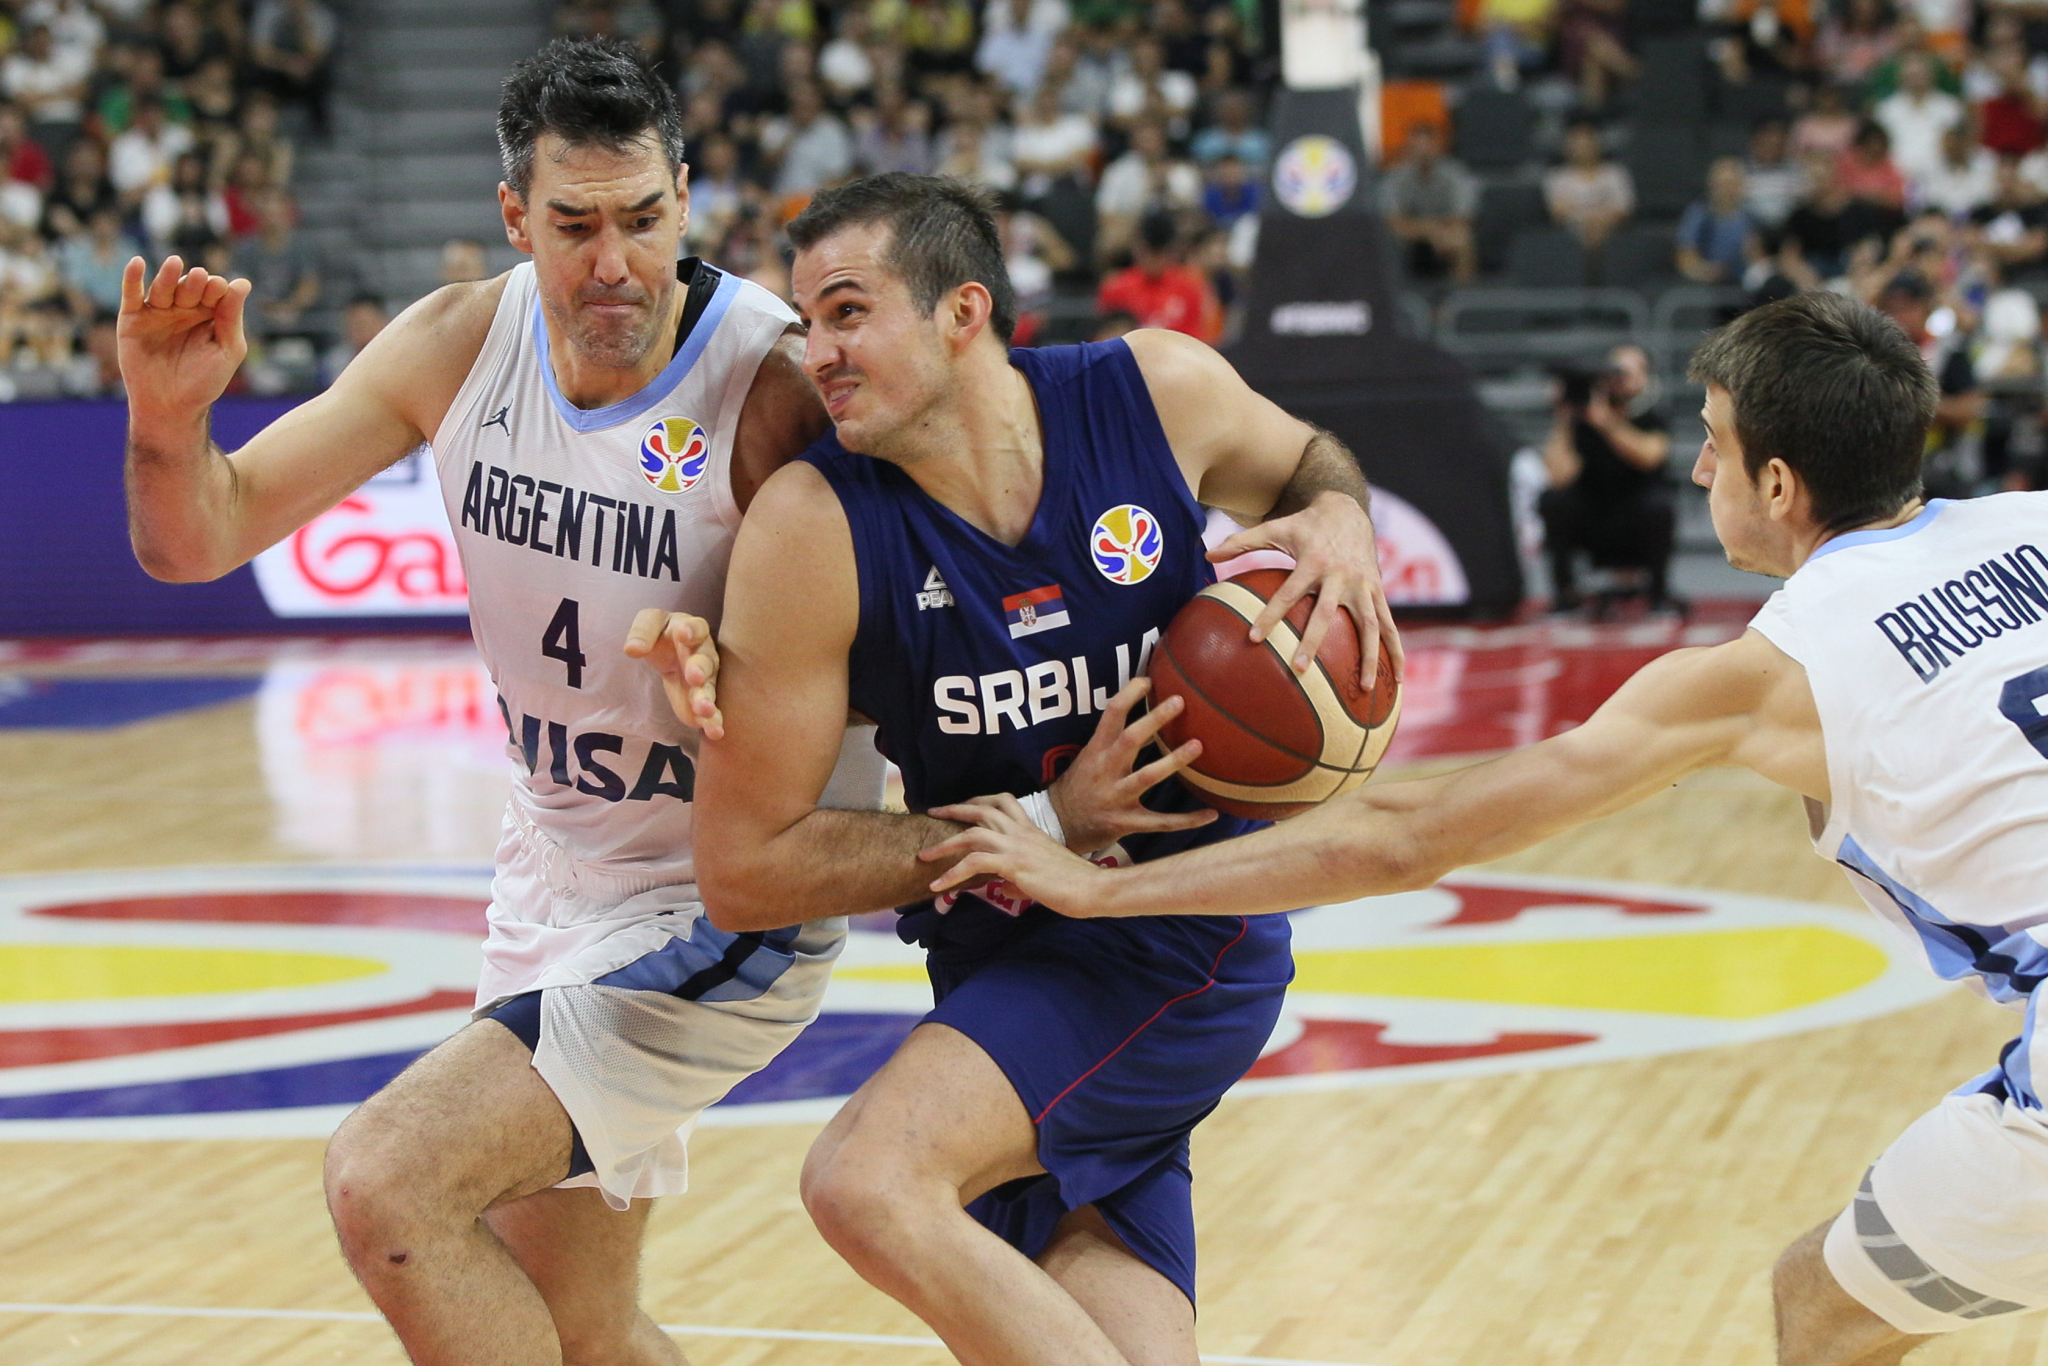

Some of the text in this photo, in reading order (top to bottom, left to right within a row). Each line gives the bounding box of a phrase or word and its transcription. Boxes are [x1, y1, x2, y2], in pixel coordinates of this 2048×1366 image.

[461, 460, 681, 582] ARGENTINA
[541, 597, 587, 689] 4
[497, 692, 695, 803] VISA
